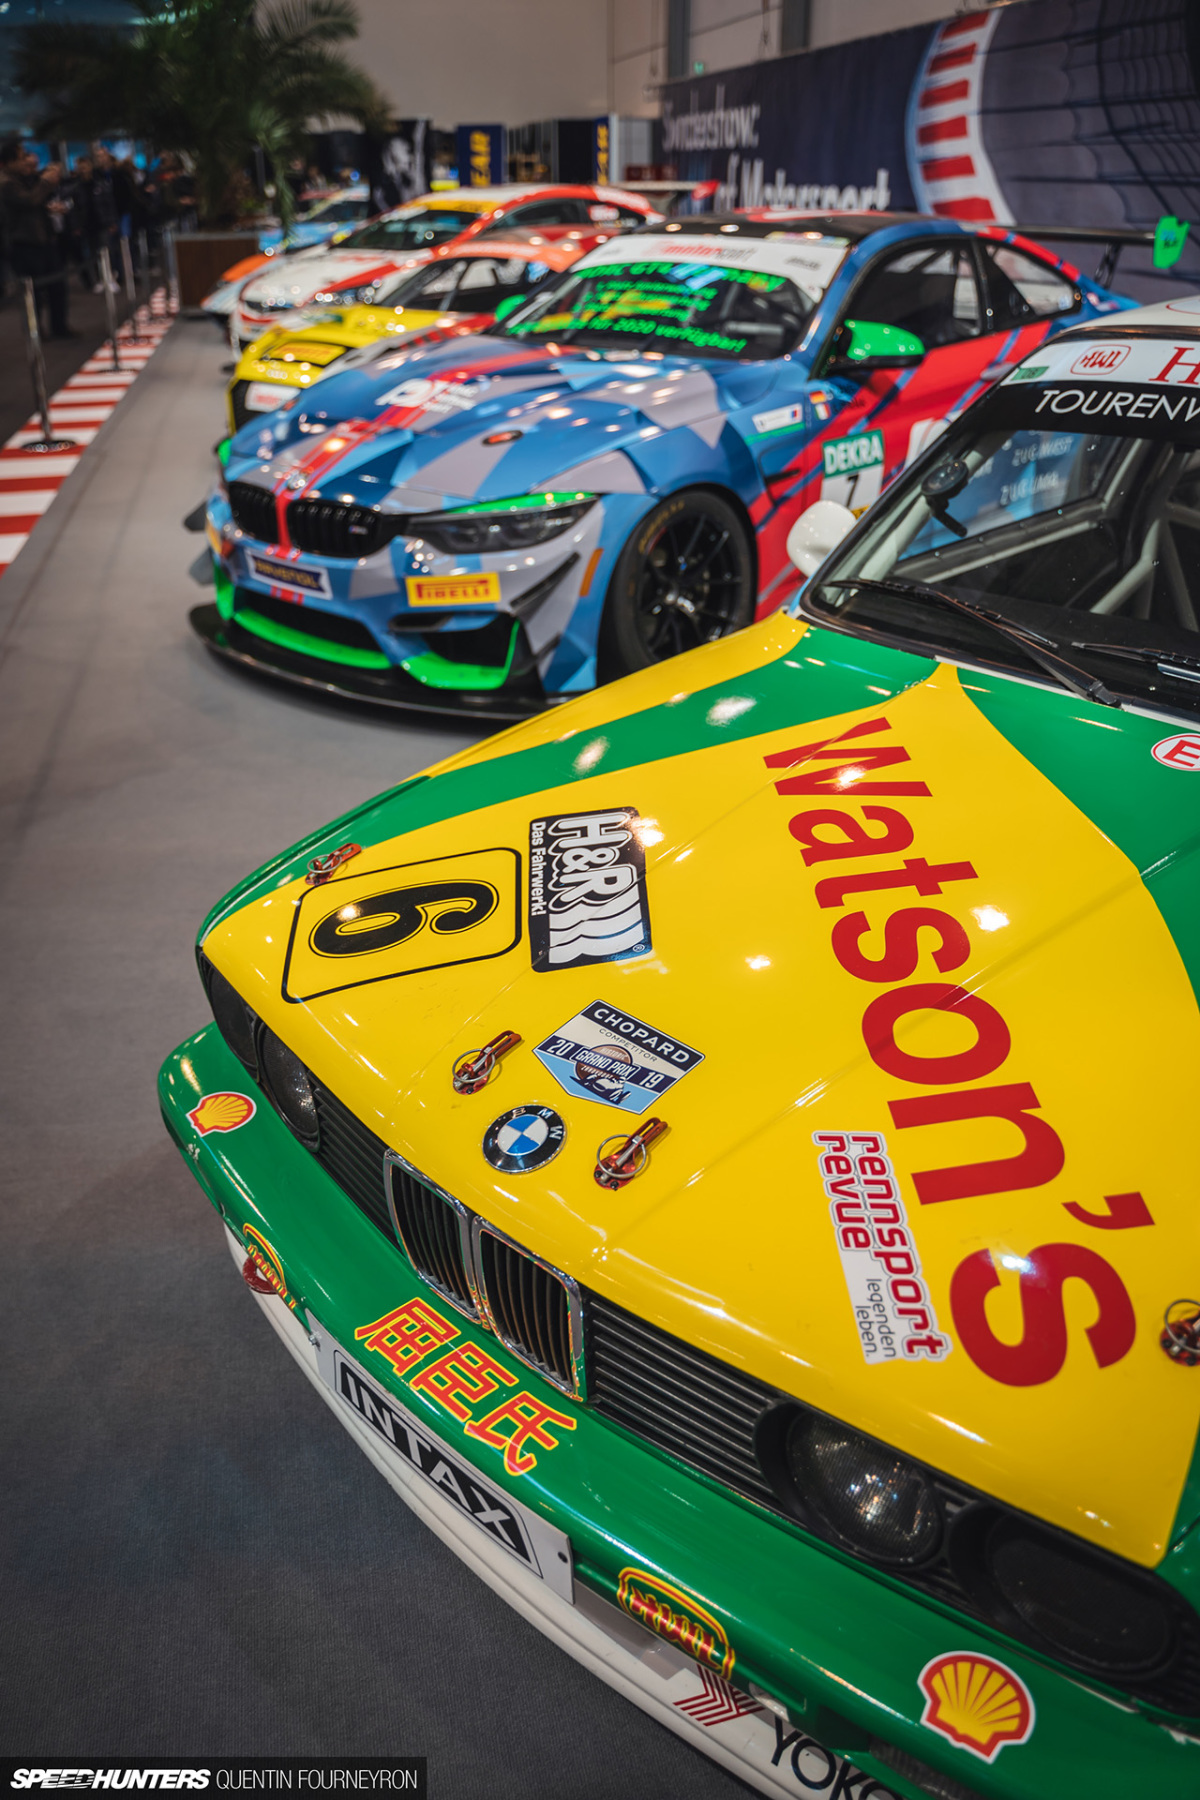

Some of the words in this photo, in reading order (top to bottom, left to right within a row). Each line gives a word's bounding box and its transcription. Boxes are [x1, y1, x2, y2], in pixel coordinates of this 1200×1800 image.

[612, 317, 656, 335] 2020
[824, 435, 883, 475] DEKRA
[846, 474, 859, 508] 7
[416, 579, 488, 600] PIRELLI
[1162, 739, 1200, 767] E
[531, 821, 546, 846] Das
[531, 847, 547, 916] Fahrwerk!
[549, 811, 637, 912] H&R
[594, 1008, 690, 1063] CHOPARD
[599, 1028, 657, 1062] COMPETITOR
[547, 1039, 575, 1056] 20
[639, 1072, 664, 1088] 19
[576, 1050, 609, 1069] GRAND
[606, 1061, 636, 1078] PRIX
[818, 1135, 872, 1249] revue
[851, 1135, 944, 1355] rennsport
[855, 1305, 878, 1357] leben.
[866, 1278, 897, 1358] legenden
[346, 1372, 519, 1550] INTAX
